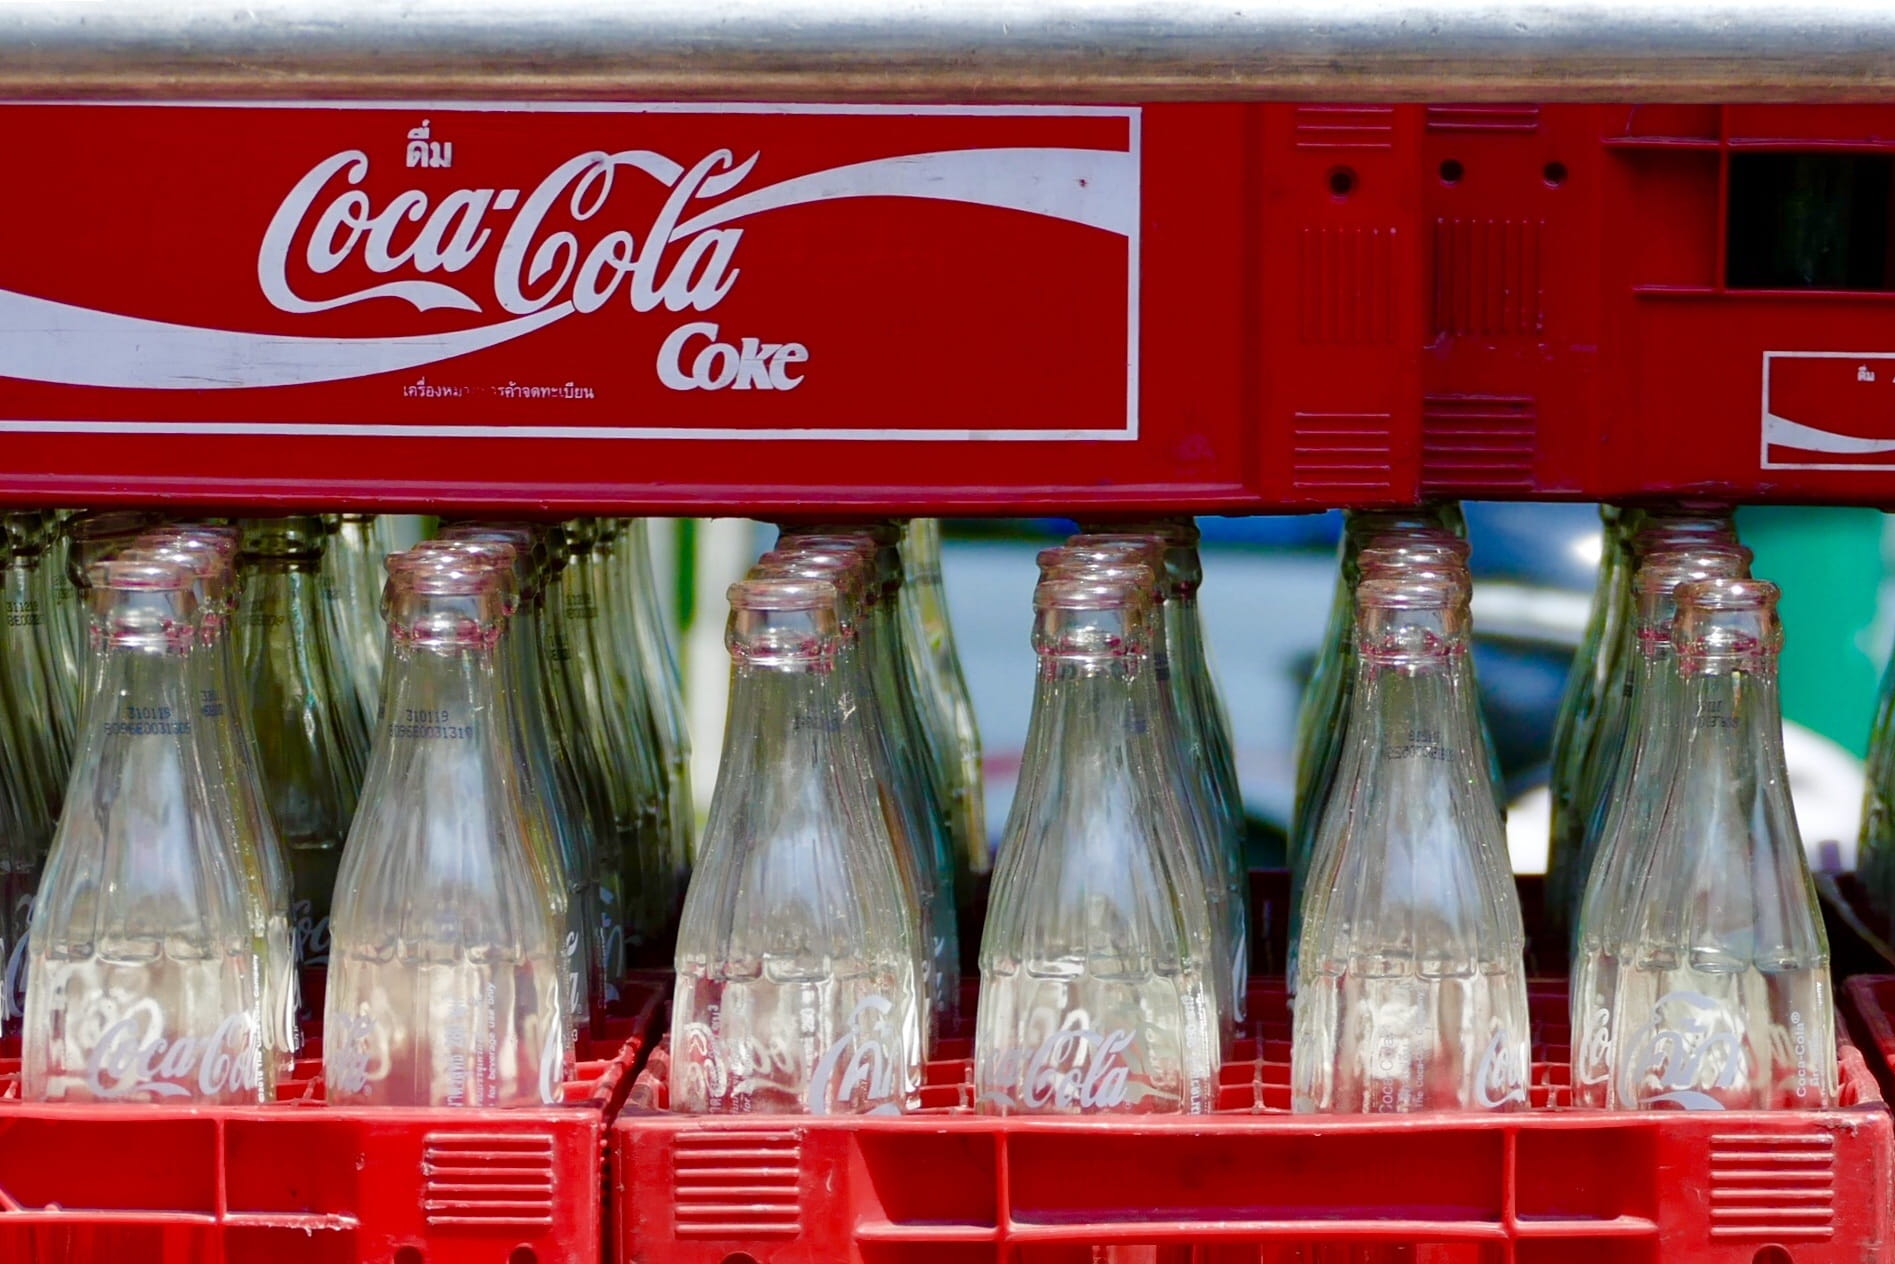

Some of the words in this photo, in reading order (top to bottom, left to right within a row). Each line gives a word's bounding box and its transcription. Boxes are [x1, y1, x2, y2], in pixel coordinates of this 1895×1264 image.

[405, 119, 453, 169] ดื่ม
[257, 148, 760, 315] Coca-Cola
[656, 321, 809, 392] Coke
